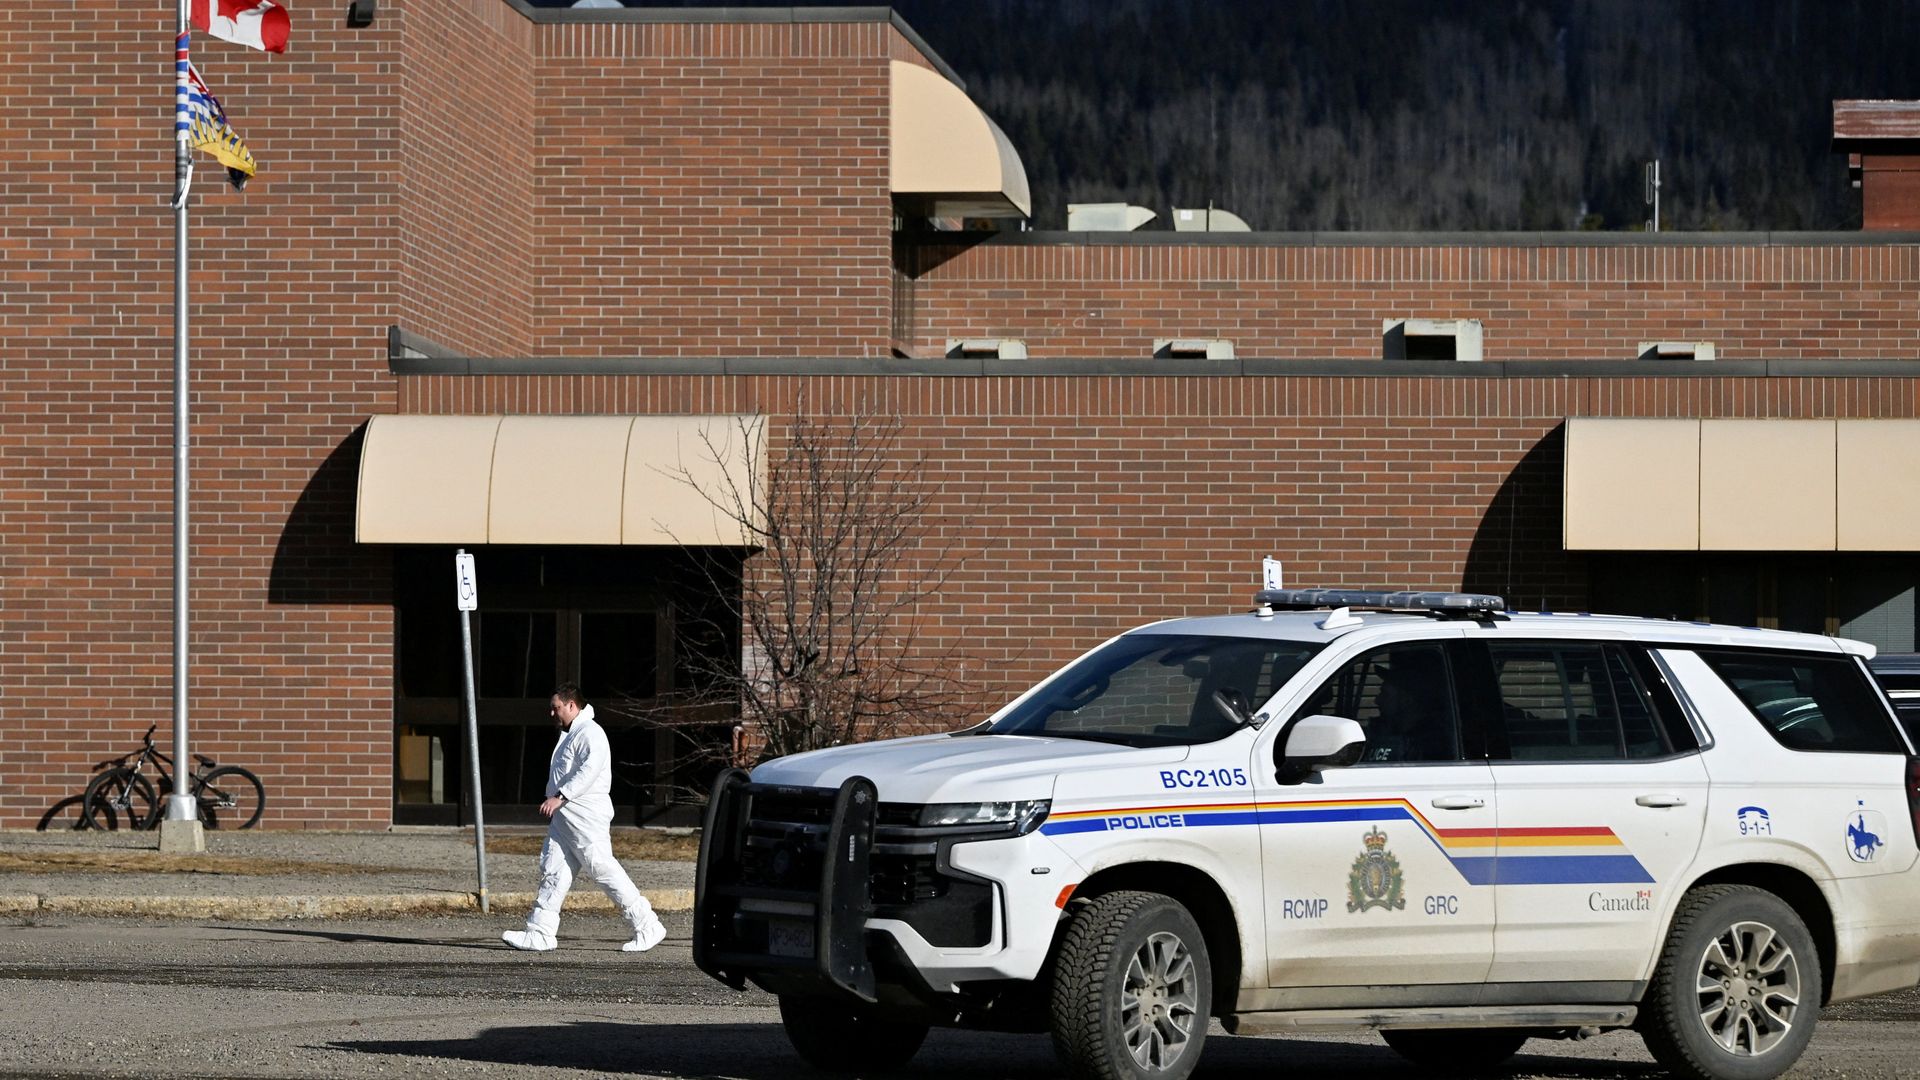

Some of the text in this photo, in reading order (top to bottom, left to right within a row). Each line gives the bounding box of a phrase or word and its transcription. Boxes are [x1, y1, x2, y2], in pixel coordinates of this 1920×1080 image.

[1160, 768, 1247, 789] BC2105
[1107, 814, 1184, 831] POLICE
[1739, 821, 1772, 836] 9-1-1
[1283, 899, 1328, 919] RCMP
[1424, 895, 1458, 916] GRC
[1588, 890, 1650, 912] Canada
